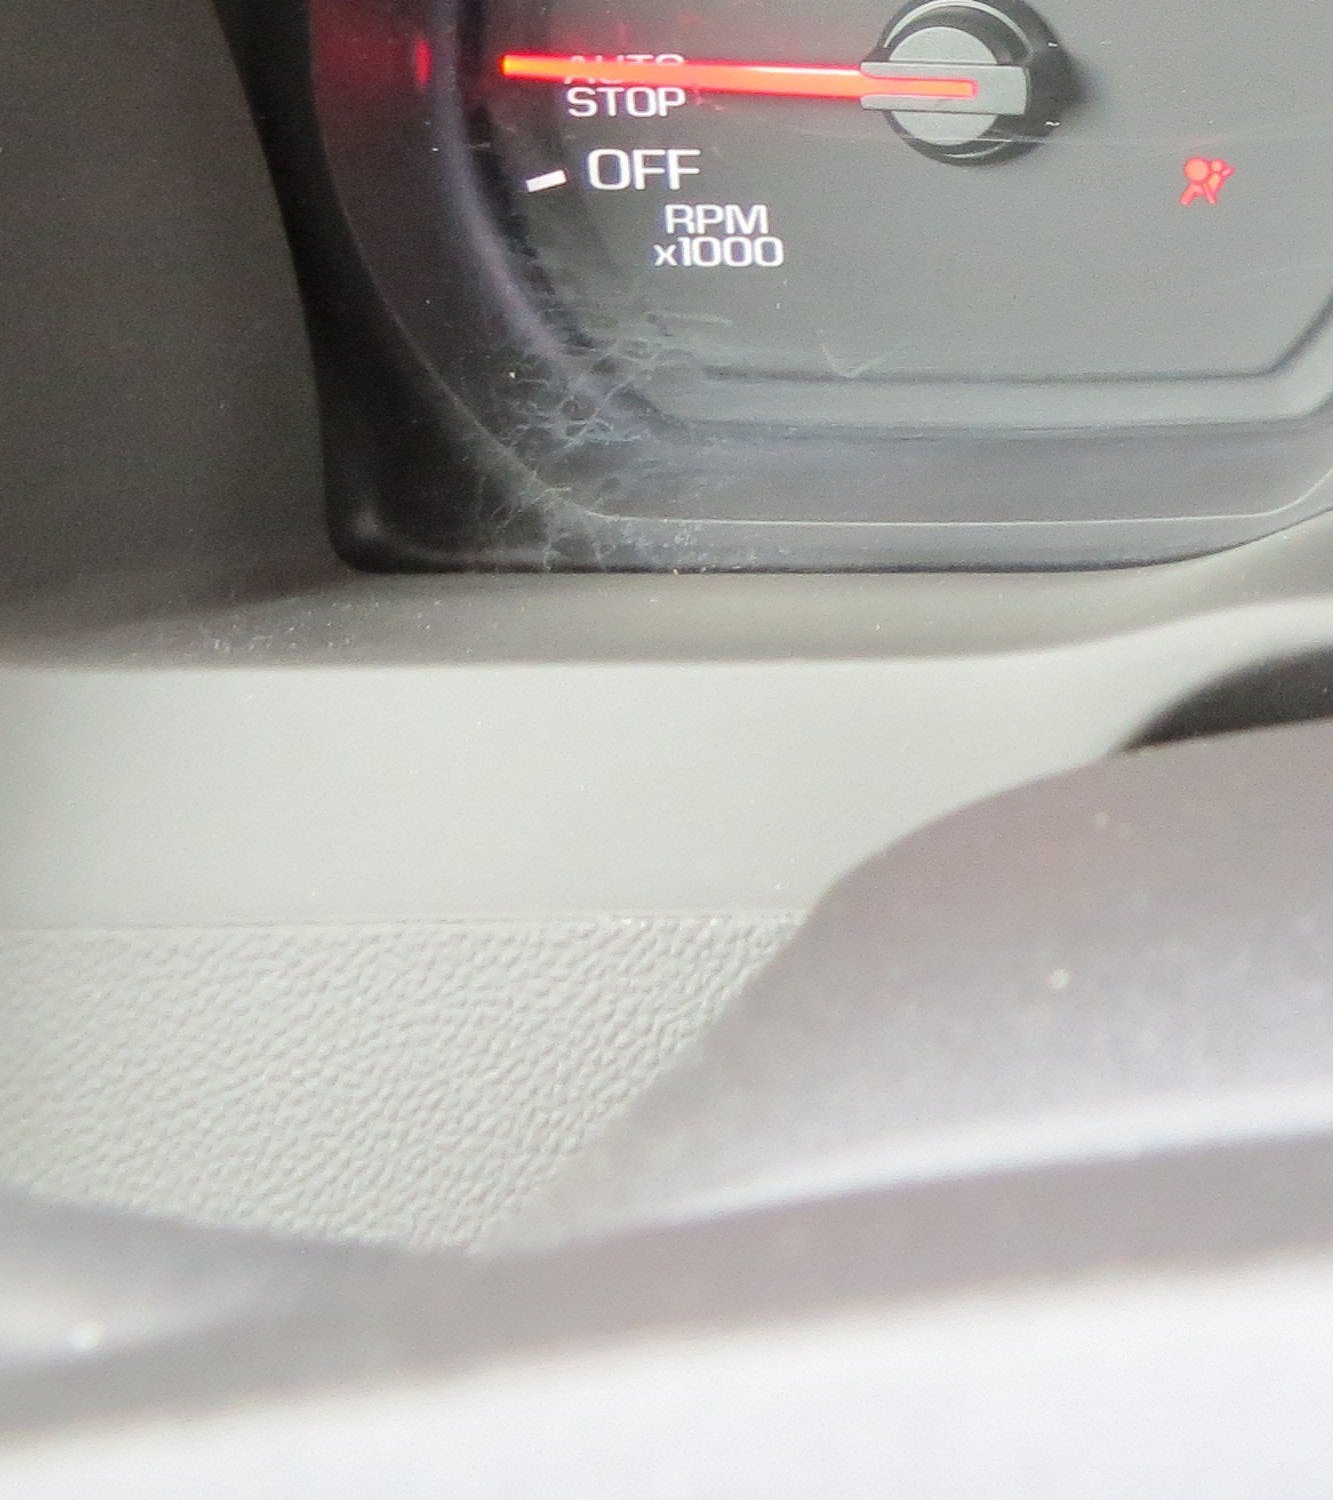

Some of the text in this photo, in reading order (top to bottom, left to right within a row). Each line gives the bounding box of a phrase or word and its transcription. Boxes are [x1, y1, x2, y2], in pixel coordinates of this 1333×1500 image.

[565, 86, 687, 117] STOP
[587, 148, 701, 190] OFF
[664, 204, 770, 235] RPM
[653, 236, 784, 267] x1000
